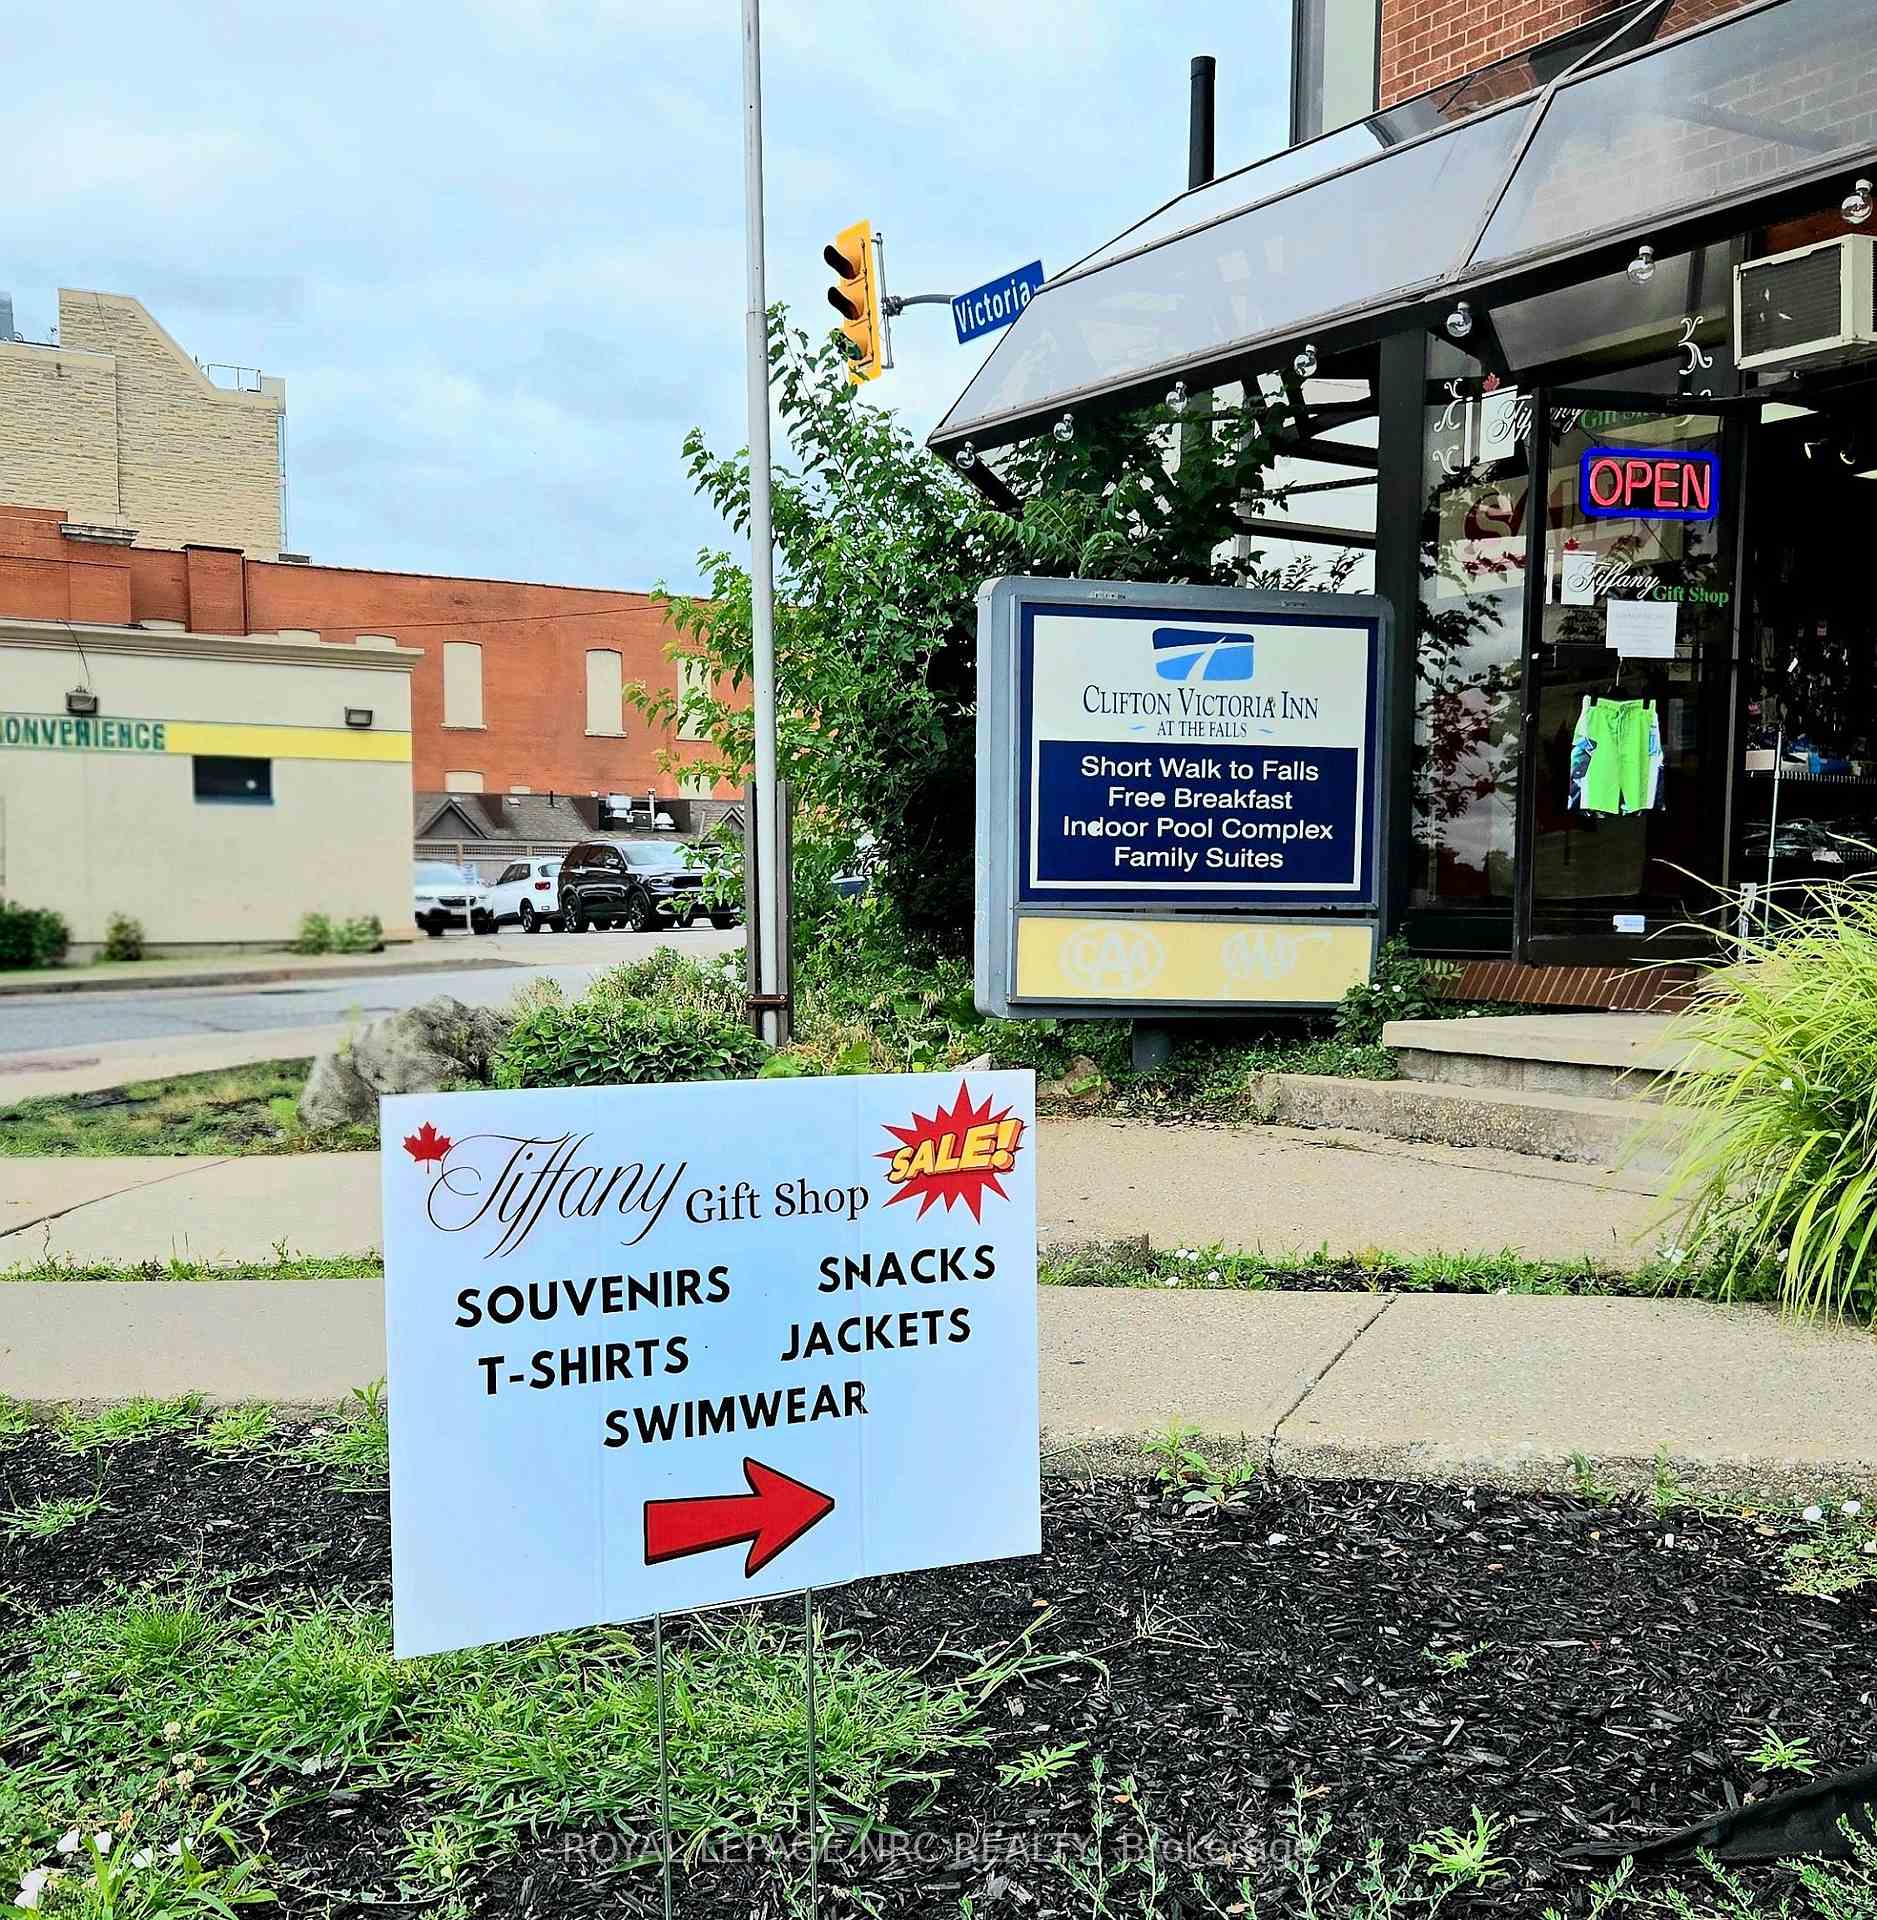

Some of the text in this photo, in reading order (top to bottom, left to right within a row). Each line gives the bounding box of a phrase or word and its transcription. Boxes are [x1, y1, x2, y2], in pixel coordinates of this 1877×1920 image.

[955, 278, 1031, 334] Victoria
[1589, 458, 1711, 509] OPEN
[1568, 561, 1729, 607] Tiffany Gift Shop
[1083, 685, 1319, 720] CLIFTON VICTORIA INN
[0, 717, 165, 750] ONVENIENCE
[1157, 720, 1248, 739] AT THE FALLS
[1081, 755, 1320, 782] Short Walk to Falls
[1108, 786, 1293, 810] Free Breakfast
[1063, 815, 1334, 844] Indoor Pool Complex
[1114, 846, 1284, 872] Family Suites
[887, 1117, 1024, 1184] SALE!
[428, 1131, 870, 1260] Tiffany Gift Shop
[817, 1244, 996, 1294] SNACKS
[454, 1265, 731, 1329] SOUVENIRS
[780, 1307, 971, 1363] JACKETS
[478, 1336, 689, 1396] T-SHIRTS
[603, 1380, 868, 1449] SWIMWEAR
